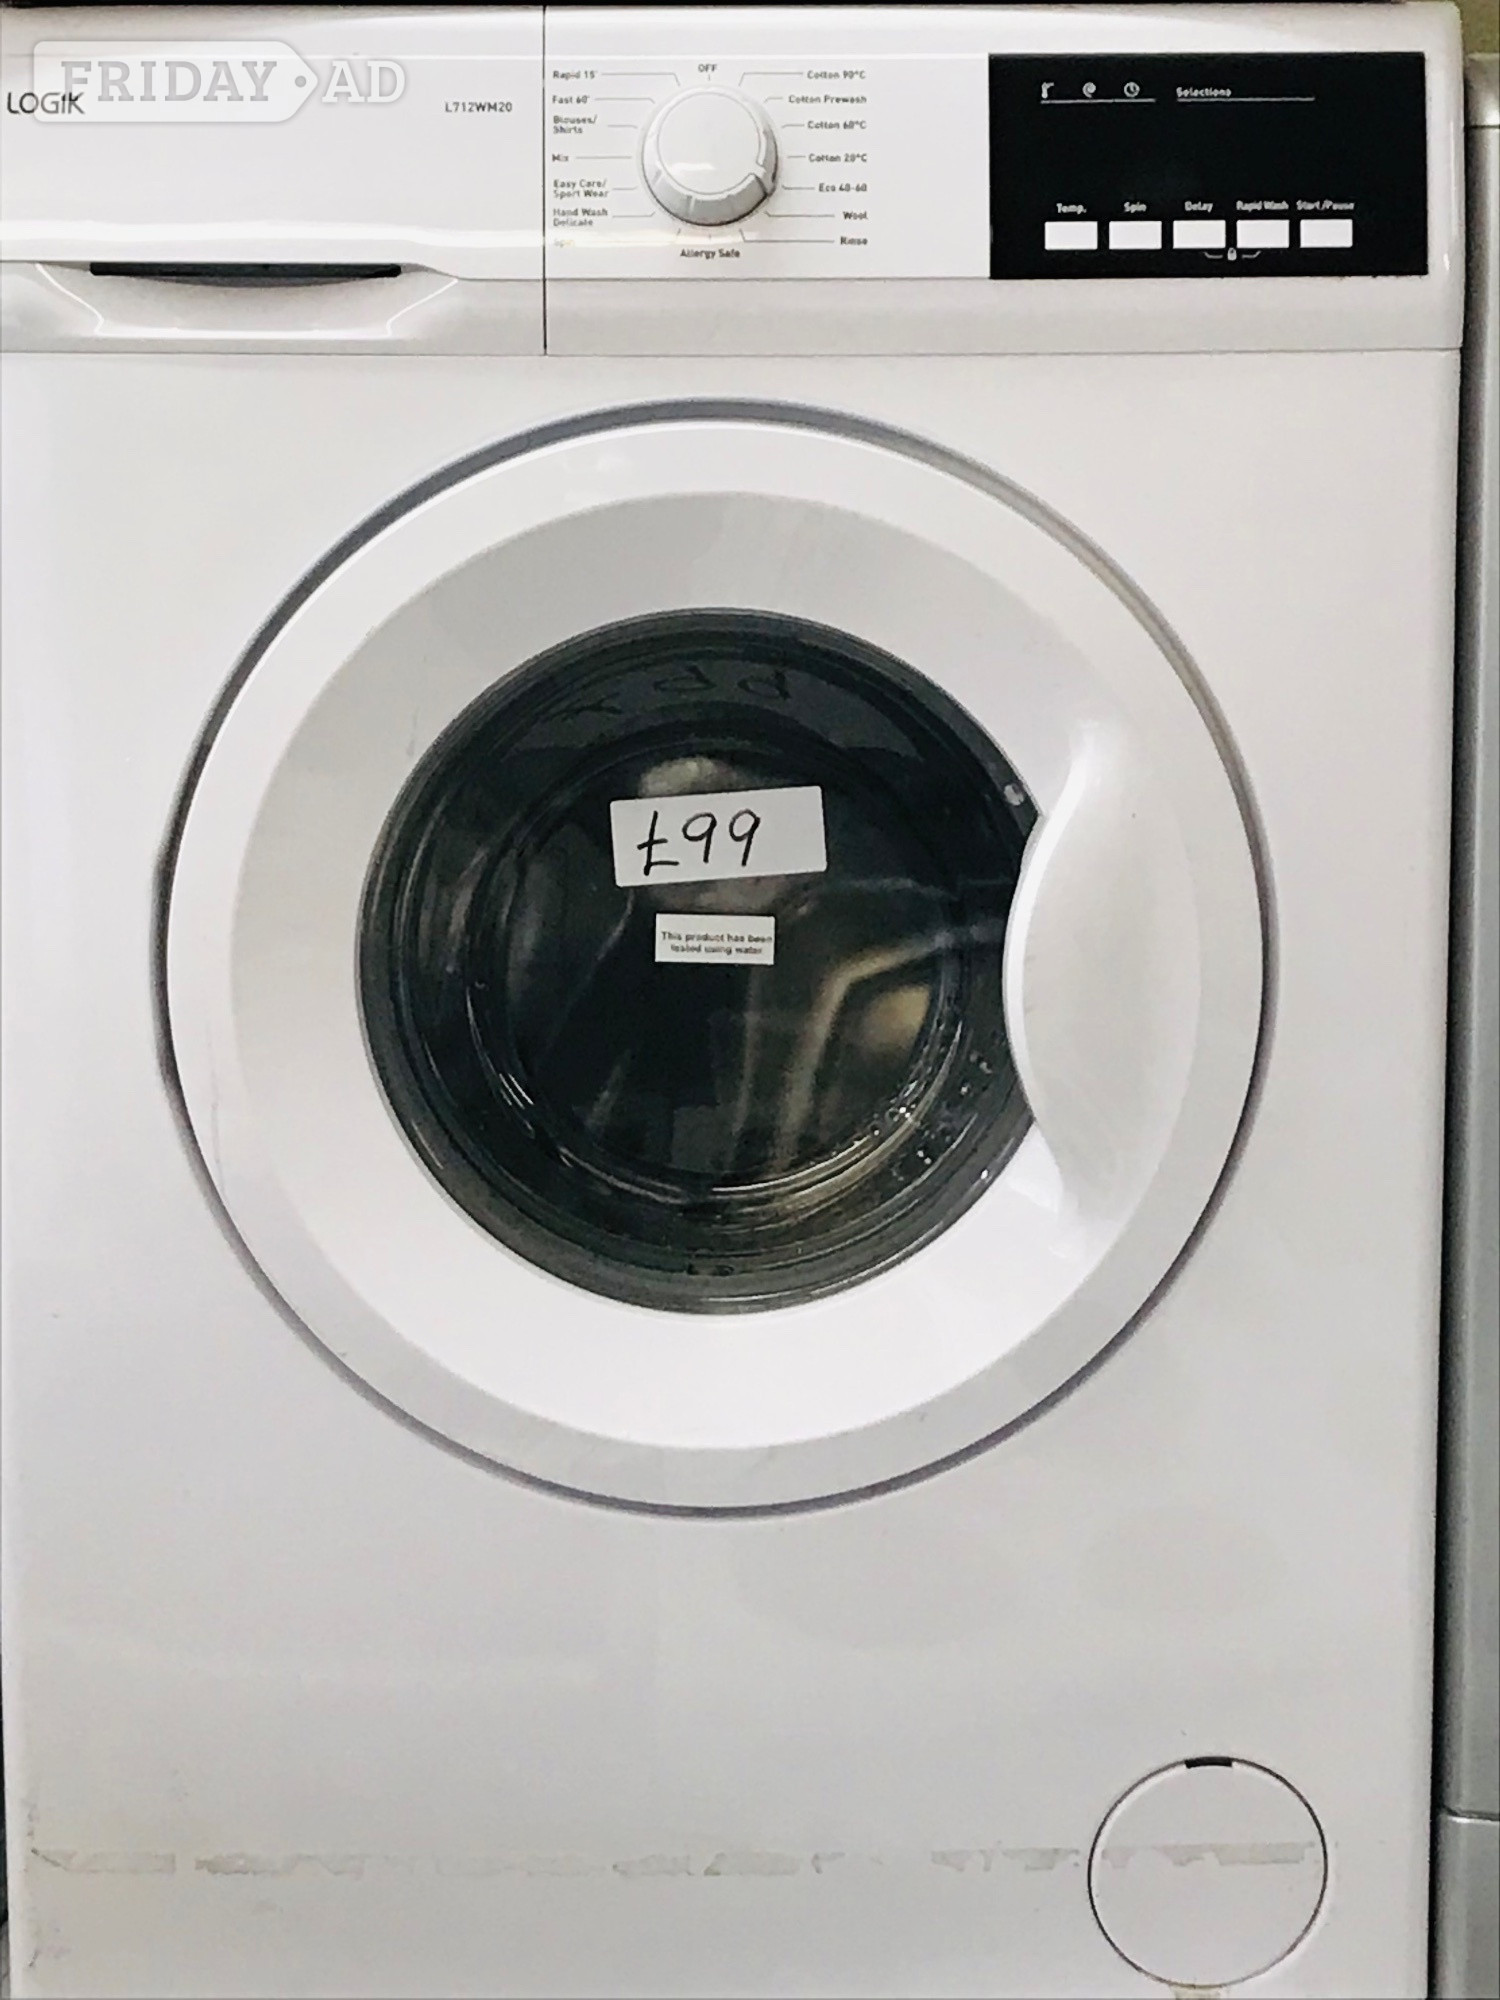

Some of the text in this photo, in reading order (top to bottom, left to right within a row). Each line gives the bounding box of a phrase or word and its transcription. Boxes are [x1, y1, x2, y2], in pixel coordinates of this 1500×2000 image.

[697, 64, 718, 73] OFF
[552, 70, 582, 81] Rapid
[806, 70, 840, 80] Cotton
[1176, 87, 1232, 98] Selections
[552, 94, 573, 104] Fast
[788, 95, 868, 105] Cotton Prewash
[444, 102, 513, 113] L712WM20
[807, 119, 840, 129] Cotton
[553, 125, 584, 134] Shirts
[551, 154, 569, 163] Mix
[808, 152, 868, 162] Cotton 20°C
[553, 179, 576, 190] Easy
[818, 183, 868, 192] Eco 40-60
[553, 190, 609, 200] Sport Wear
[1055, 202, 1087, 214] Temp.
[1123, 202, 1148, 214] Spin
[1184, 200, 1214, 212] Delay
[1235, 200, 1290, 213] Rapid Wash
[553, 208, 609, 217] Hand Wash
[842, 211, 869, 221] Wool
[839, 235, 869, 246] Rinse
[679, 247, 741, 261] Allergy Safe
[636, 808, 762, 877] £99
[661, 931, 773, 943] This product has been
[704, 945, 732, 955] using
[735, 946, 763, 954] water
